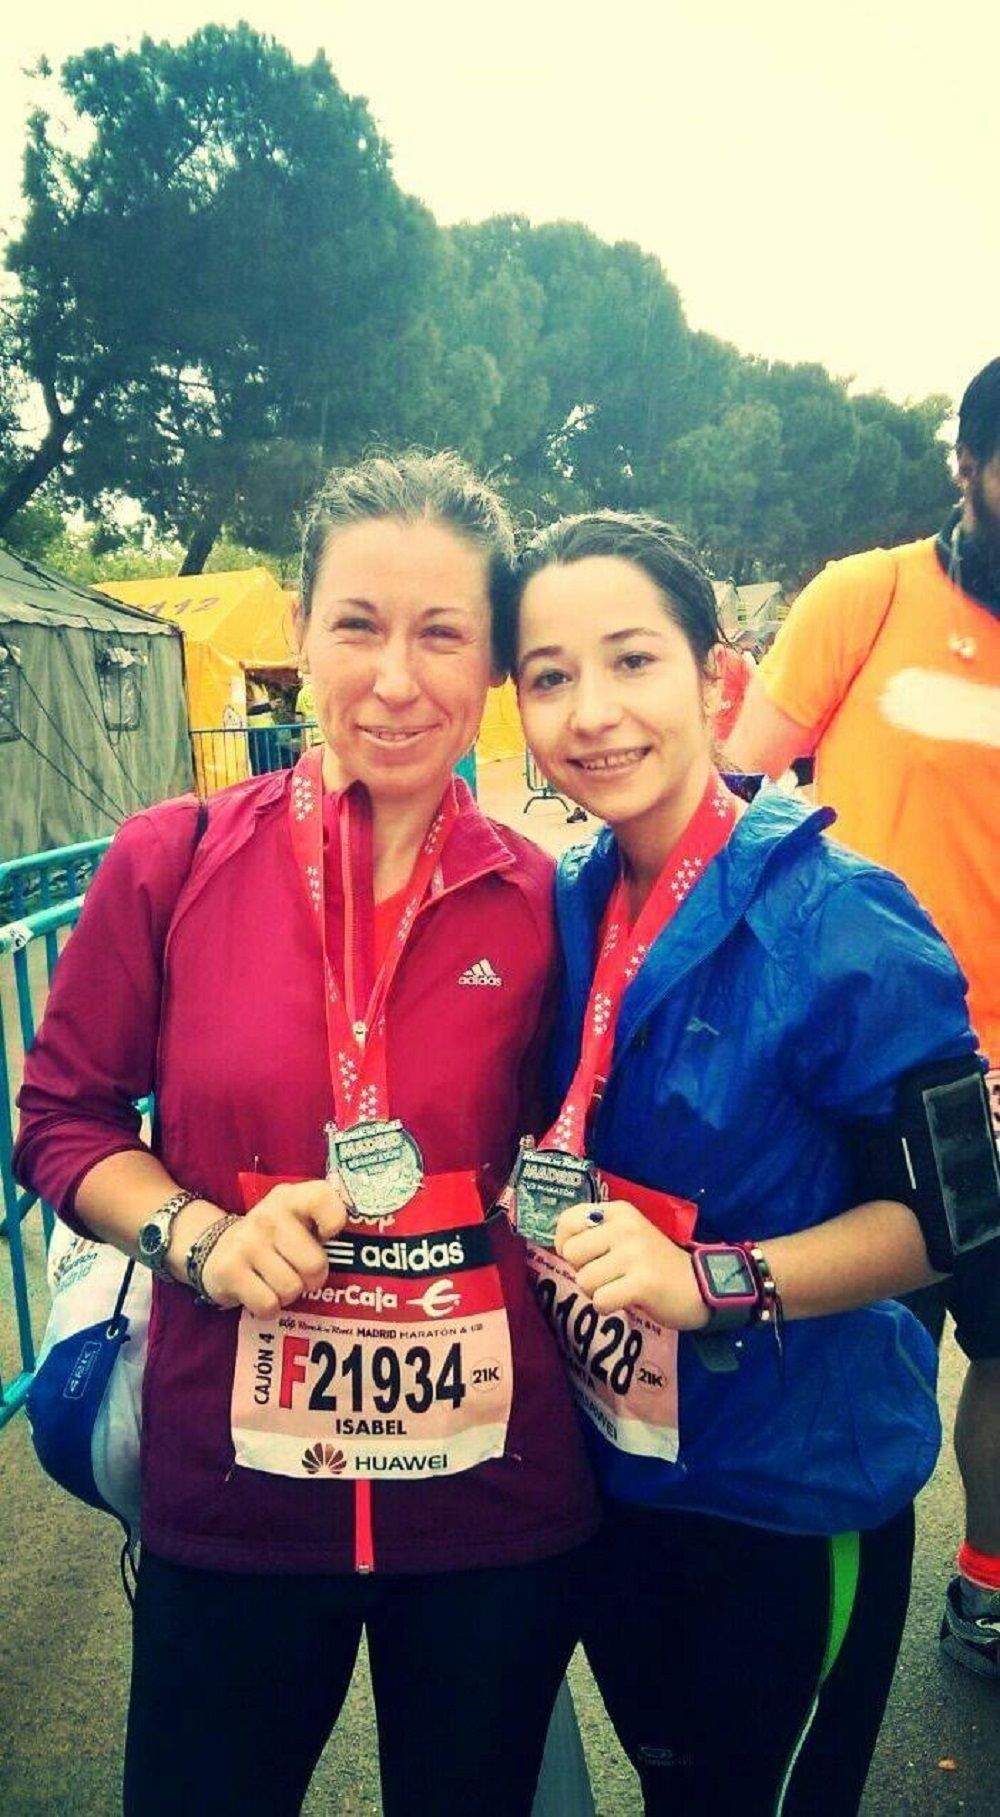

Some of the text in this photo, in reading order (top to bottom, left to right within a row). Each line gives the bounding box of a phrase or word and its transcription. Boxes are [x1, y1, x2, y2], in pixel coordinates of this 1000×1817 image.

[147, 596, 220, 616] 112
[458, 974, 503, 988] adidas
[361, 1238, 465, 1271] adidas
[357, 1327, 397, 1339] MADRID
[253, 1332, 275, 1405] CAJÓN 4
[278, 1334, 466, 1414] F21934
[472, 1366, 500, 1384] 21K
[638, 1367, 663, 1388] 21K
[336, 1419, 407, 1435] ISABEL
[355, 1454, 448, 1471] HUAWEI
